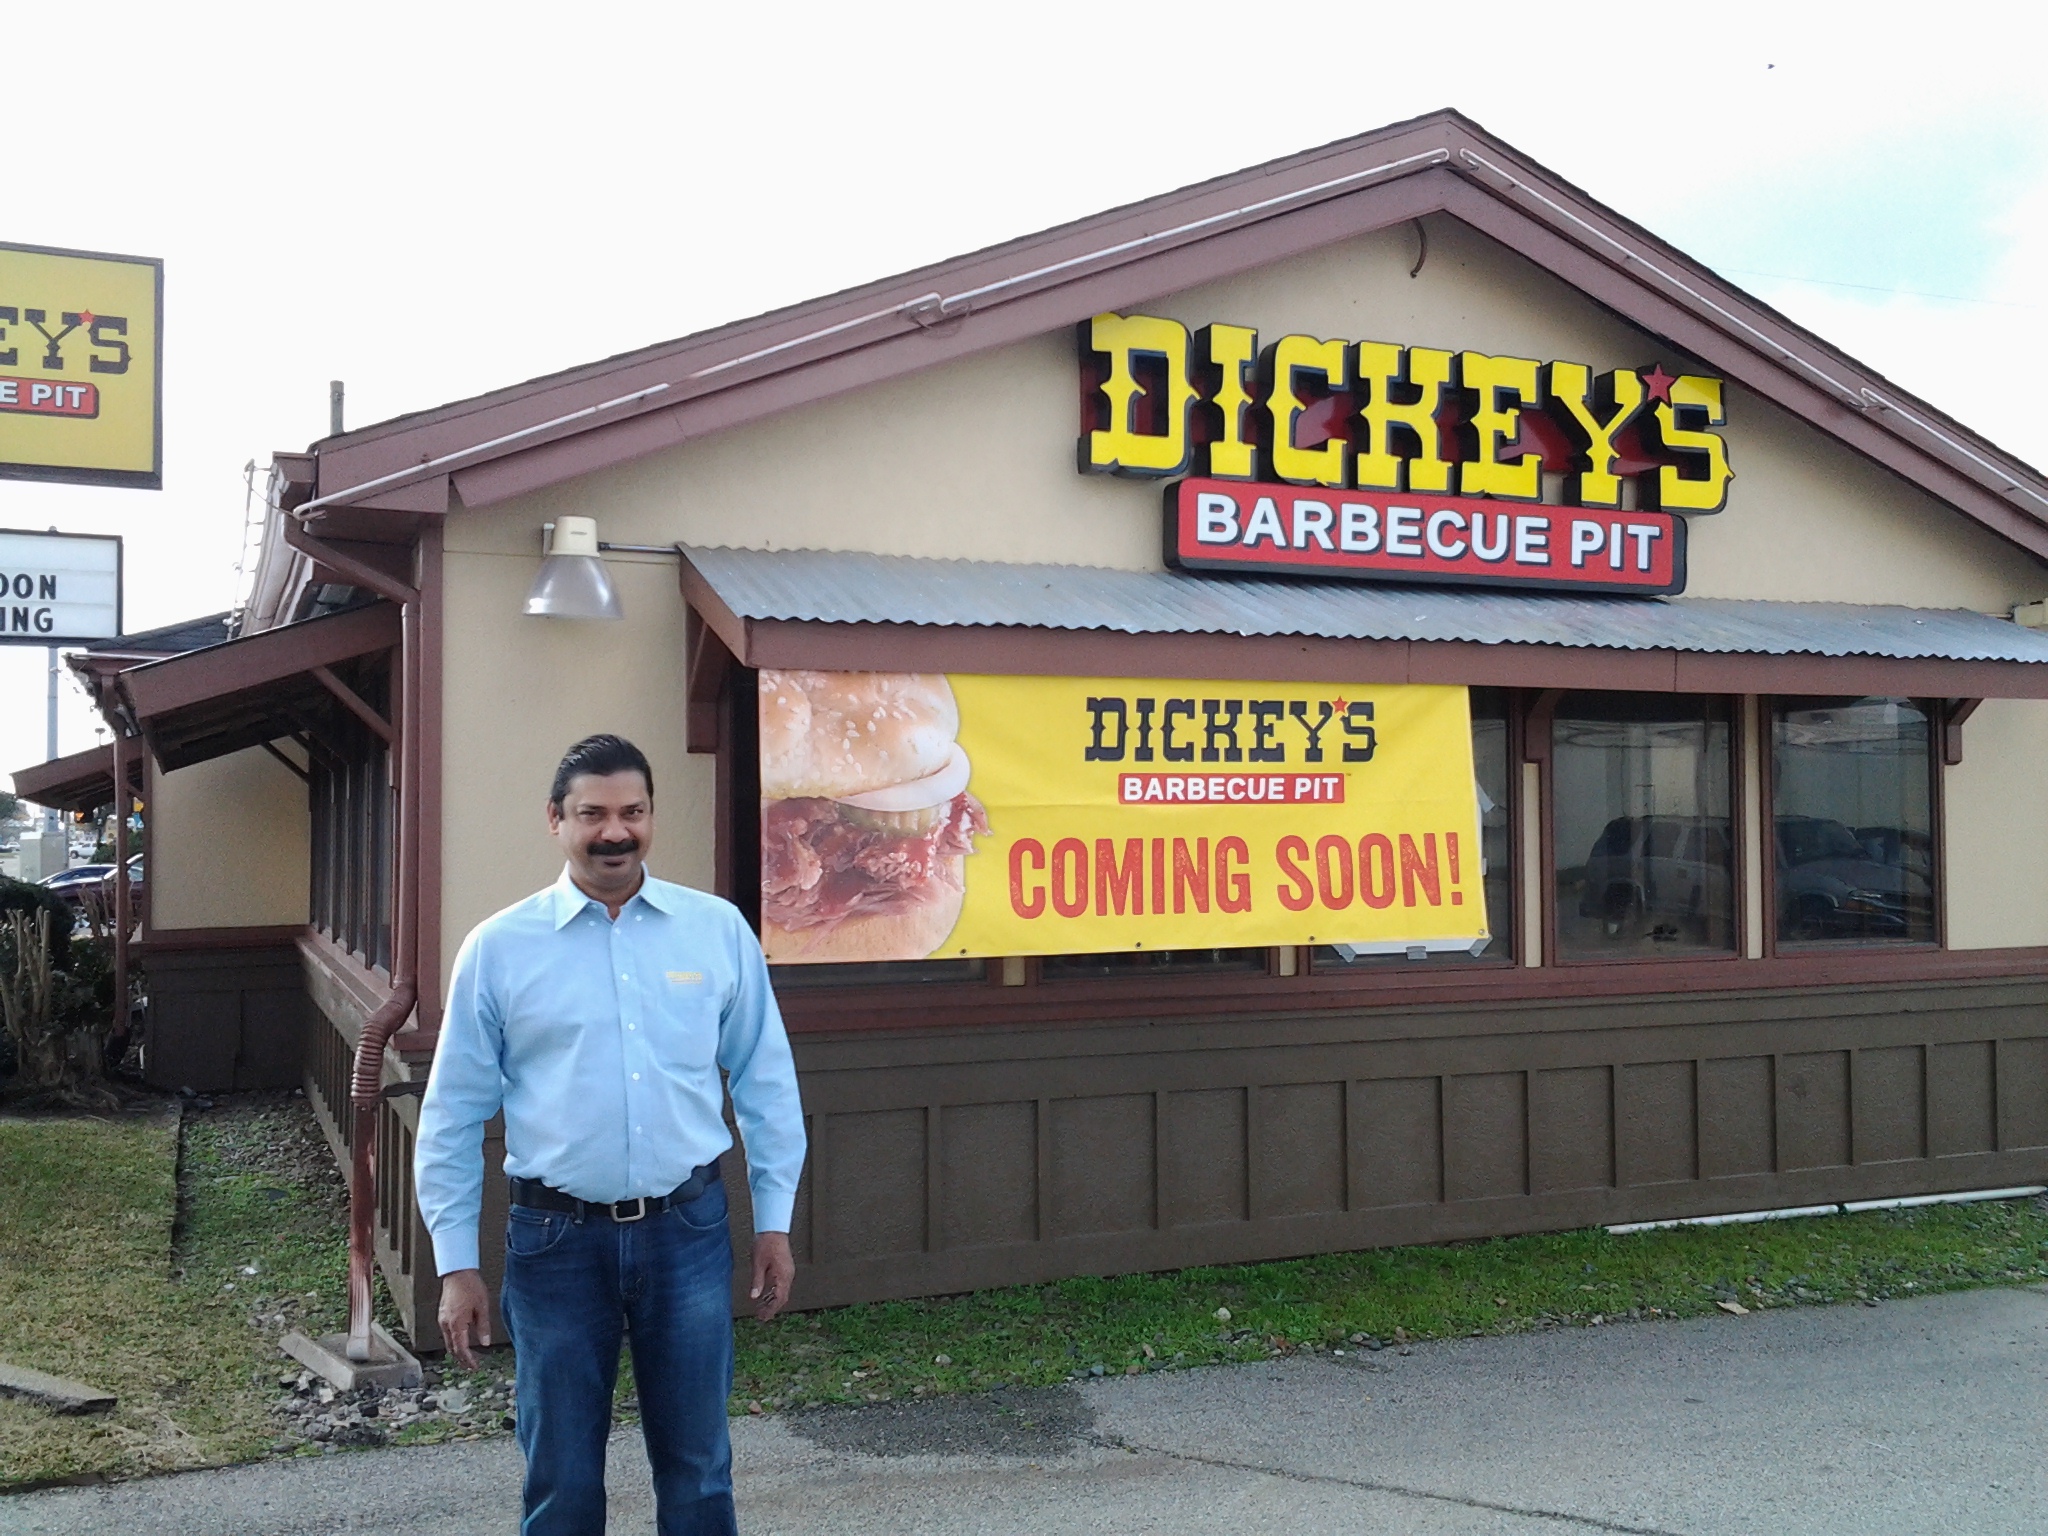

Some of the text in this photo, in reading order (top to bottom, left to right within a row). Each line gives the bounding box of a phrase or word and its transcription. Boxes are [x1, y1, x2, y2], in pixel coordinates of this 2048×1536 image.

[31, 383, 88, 409] PIT
[1196, 491, 1661, 571] BARBECUE PIT
[1123, 776, 1339, 801] BARBECUE PIT
[1008, 831, 1464, 919] COMING SOON!
